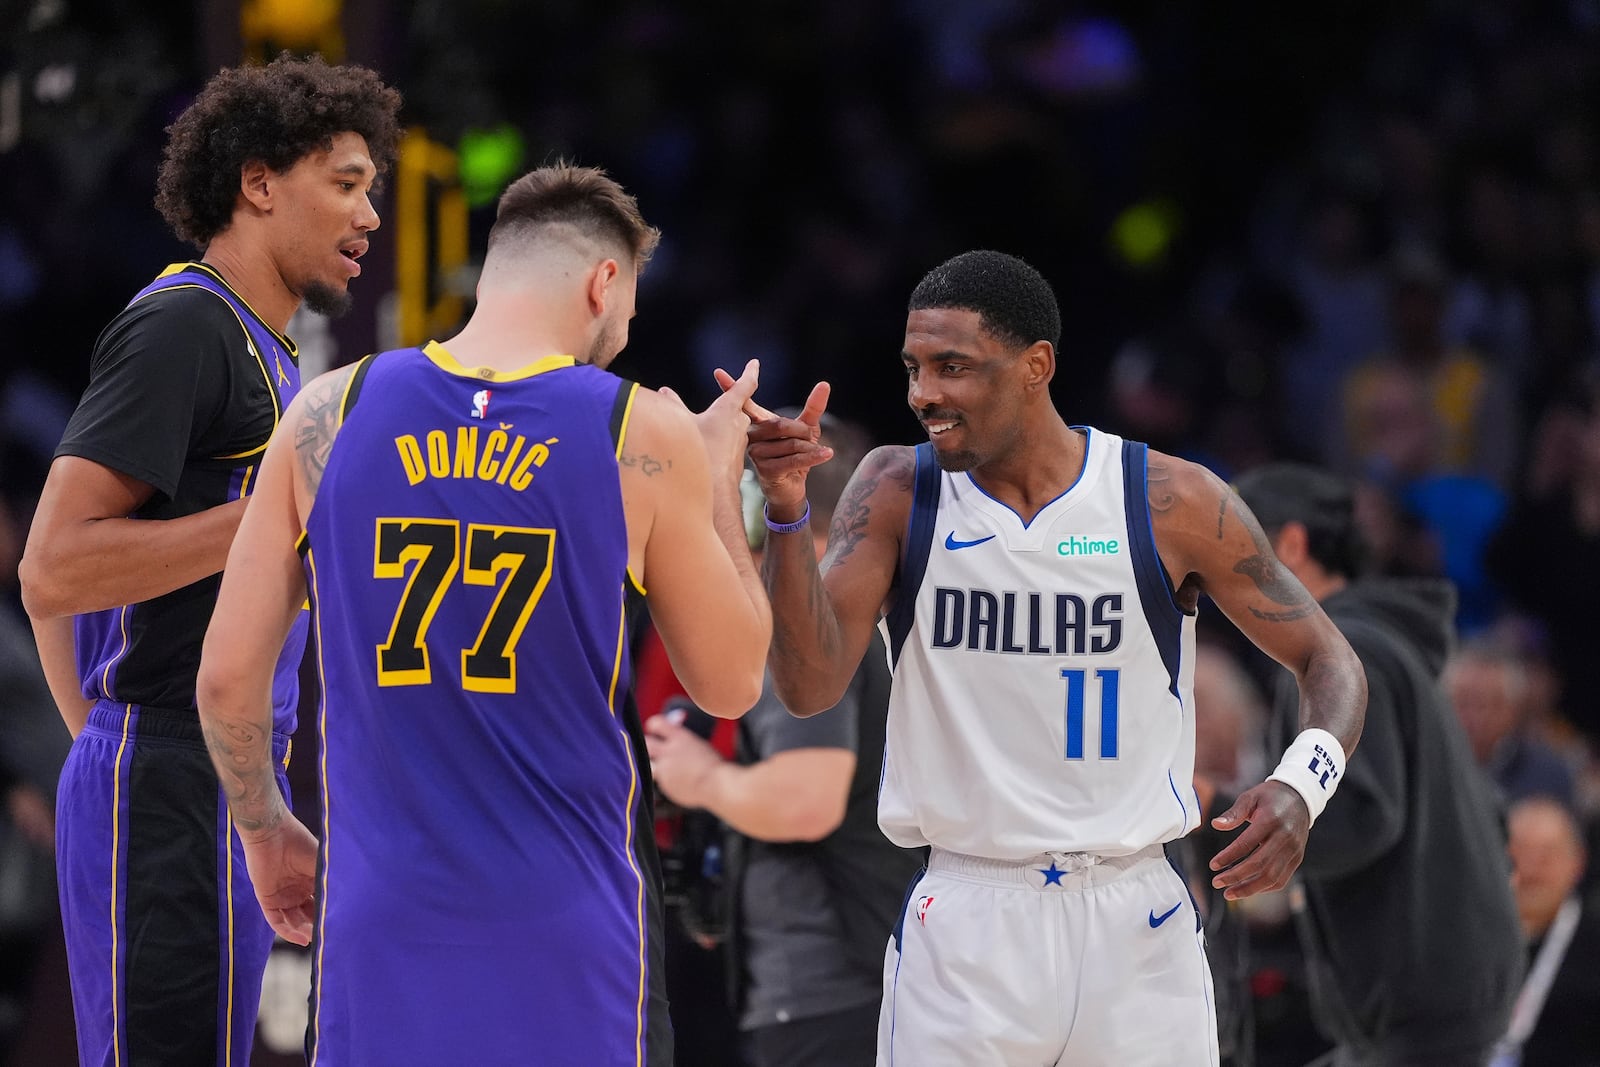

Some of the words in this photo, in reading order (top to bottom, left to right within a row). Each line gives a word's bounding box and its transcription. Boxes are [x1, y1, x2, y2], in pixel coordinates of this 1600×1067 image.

[394, 422, 560, 492] DONČIĆ
[1057, 536, 1119, 556] chime
[373, 517, 557, 694] 77
[930, 586, 1125, 656] DALLAS
[1059, 667, 1122, 761] 11
[1308, 756, 1330, 791] 11
